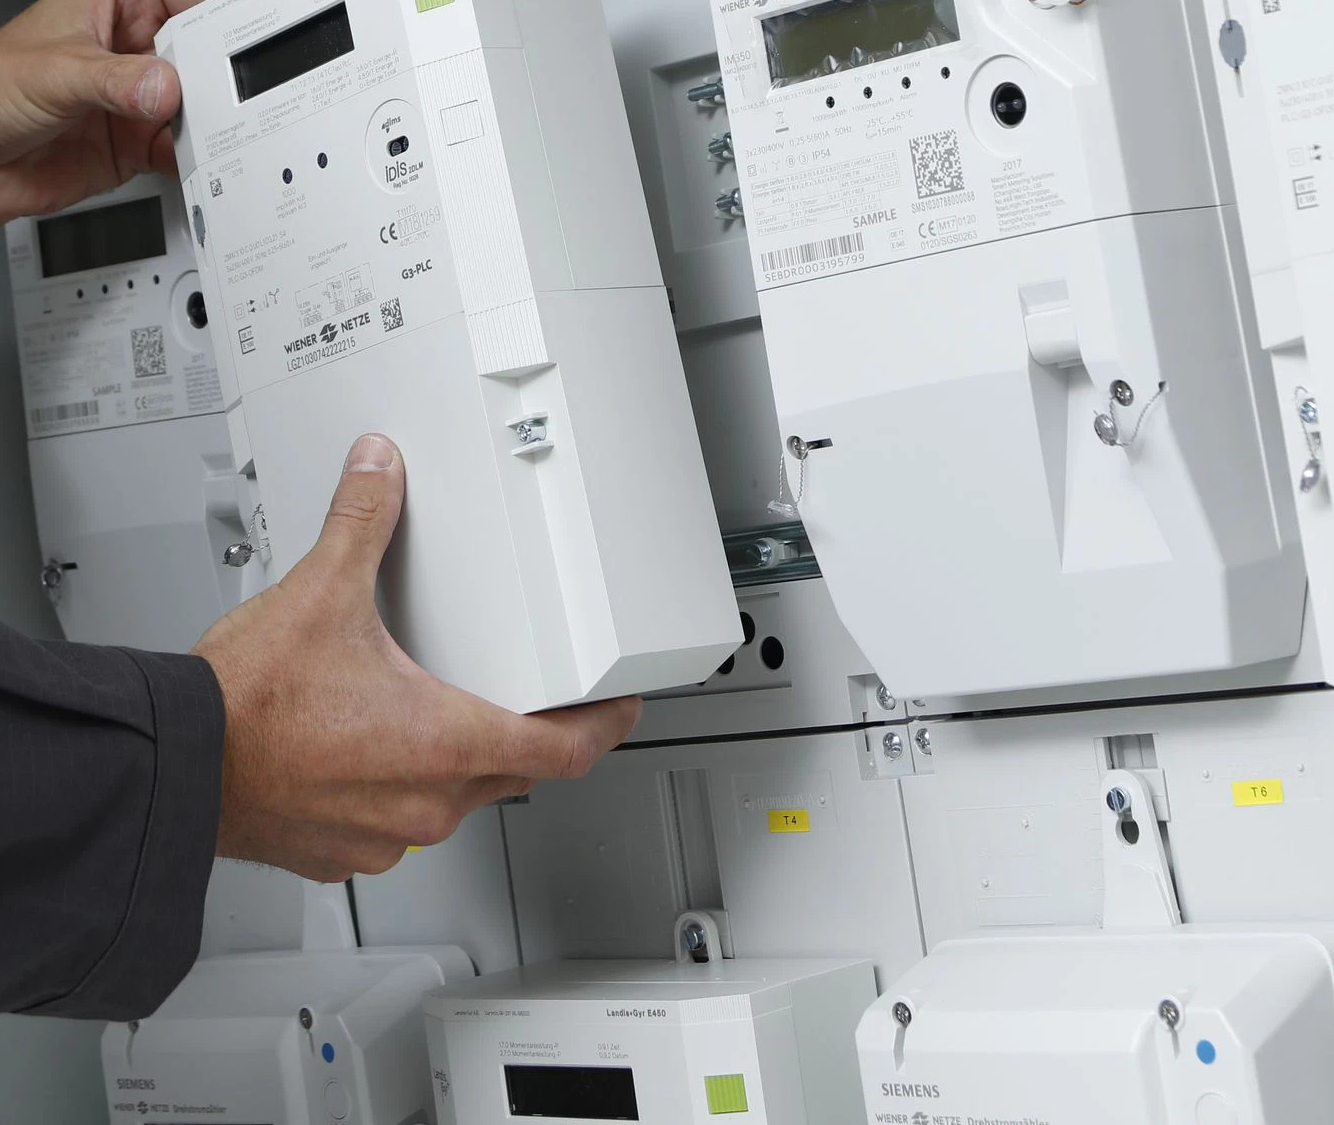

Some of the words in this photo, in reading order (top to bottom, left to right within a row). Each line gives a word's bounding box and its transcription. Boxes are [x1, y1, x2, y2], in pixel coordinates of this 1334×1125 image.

[834, 125, 851, 135] 50Hz
[812, 147, 830, 159] IP54
[408, 161, 423, 173] 2DLM
[1002, 158, 1022, 171] 2017
[420, 205, 441, 226] 1259
[852, 208, 897, 228] SAMPLE
[938, 218, 955, 230] M17
[957, 213, 976, 226] 0120
[401, 258, 432, 279] G3-PLC
[764, 253, 864, 282] SEBDR0003195799
[284, 333, 317, 354] WIENER
[340, 312, 370, 332] NETZE
[286, 336, 355, 371] LGZ1030742222215
[92, 383, 122, 396] SAMPLE
[1261, 786, 1268, 797] 6
[606, 1009, 645, 1019] Landis+Gyr
[647, 1009, 667, 1017] E450
[116, 1078, 156, 1090] SIEMENS
[881, 1083, 940, 1098] SIEMENS
[875, 1112, 908, 1125] WIENER
[932, 1115, 961, 1125] NETZE
